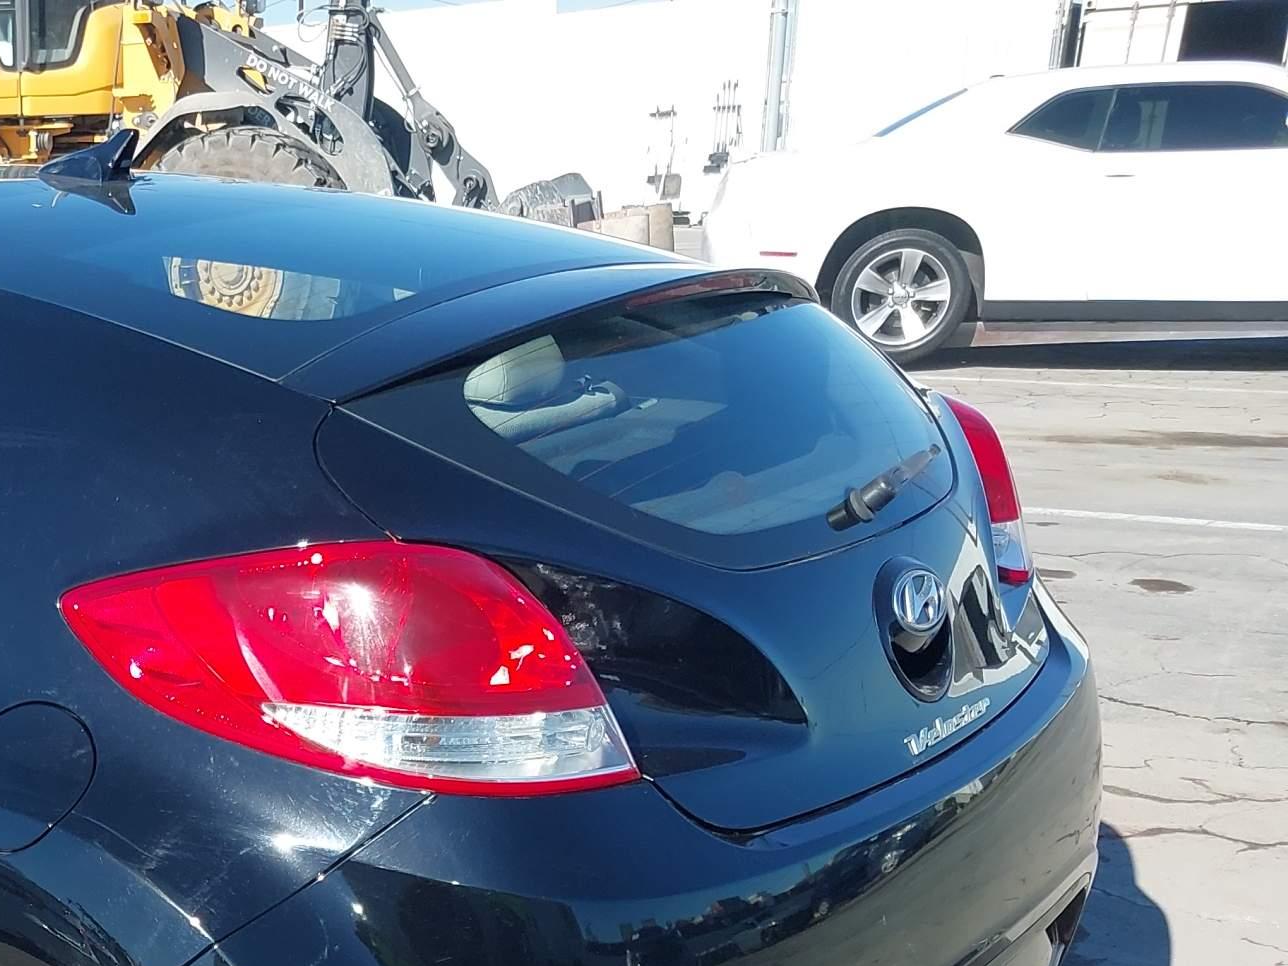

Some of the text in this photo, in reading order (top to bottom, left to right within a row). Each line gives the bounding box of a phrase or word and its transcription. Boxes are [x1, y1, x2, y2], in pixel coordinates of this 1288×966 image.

[246, 54, 334, 112] DO NOT WALK
[903, 697, 991, 756] Veloster
